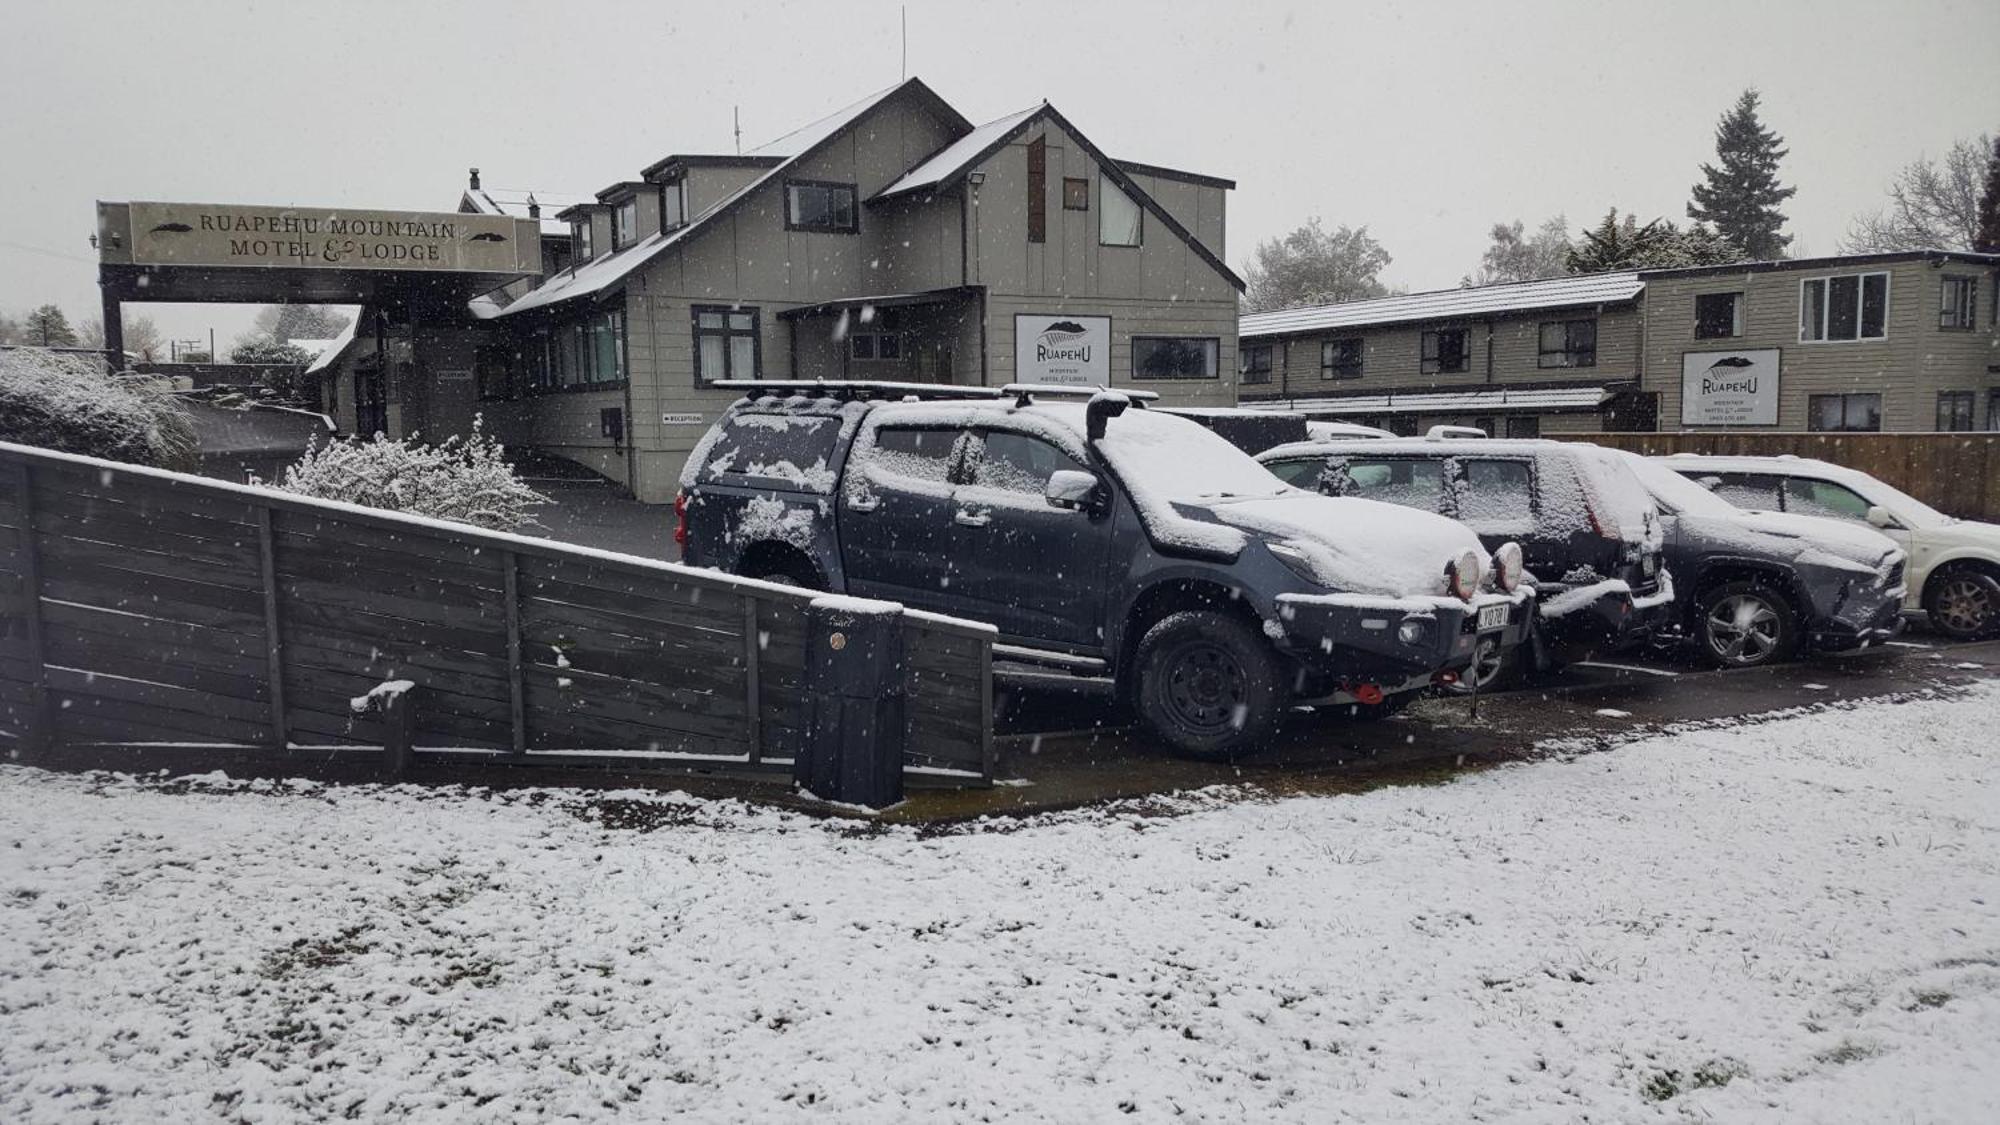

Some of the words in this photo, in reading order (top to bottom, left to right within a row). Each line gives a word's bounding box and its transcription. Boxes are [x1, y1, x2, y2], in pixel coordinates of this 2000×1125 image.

[200, 214, 317, 234] RUAPEHU
[331, 219, 455, 239] MOUNTAIN
[230, 239, 317, 257] MOTEL
[323, 239, 355, 262] &
[360, 243, 440, 261] LODGE
